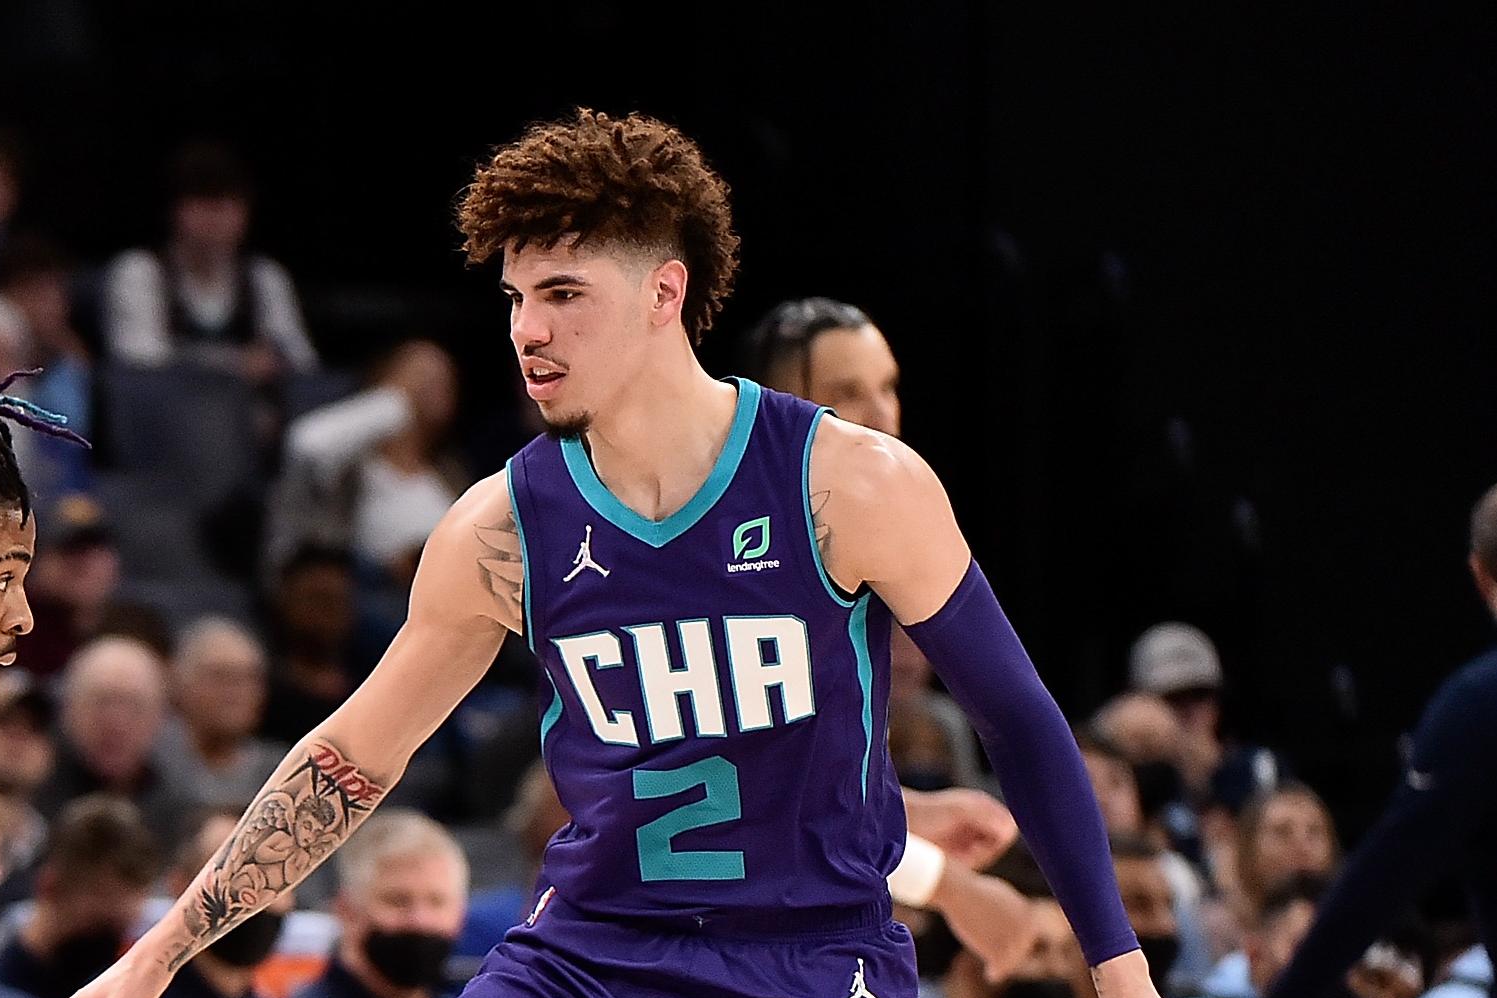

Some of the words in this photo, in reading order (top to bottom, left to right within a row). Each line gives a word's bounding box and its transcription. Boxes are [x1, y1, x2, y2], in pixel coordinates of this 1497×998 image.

[727, 559, 780, 573] lendingtree
[549, 614, 816, 748] CHA
[632, 755, 746, 882] 2
